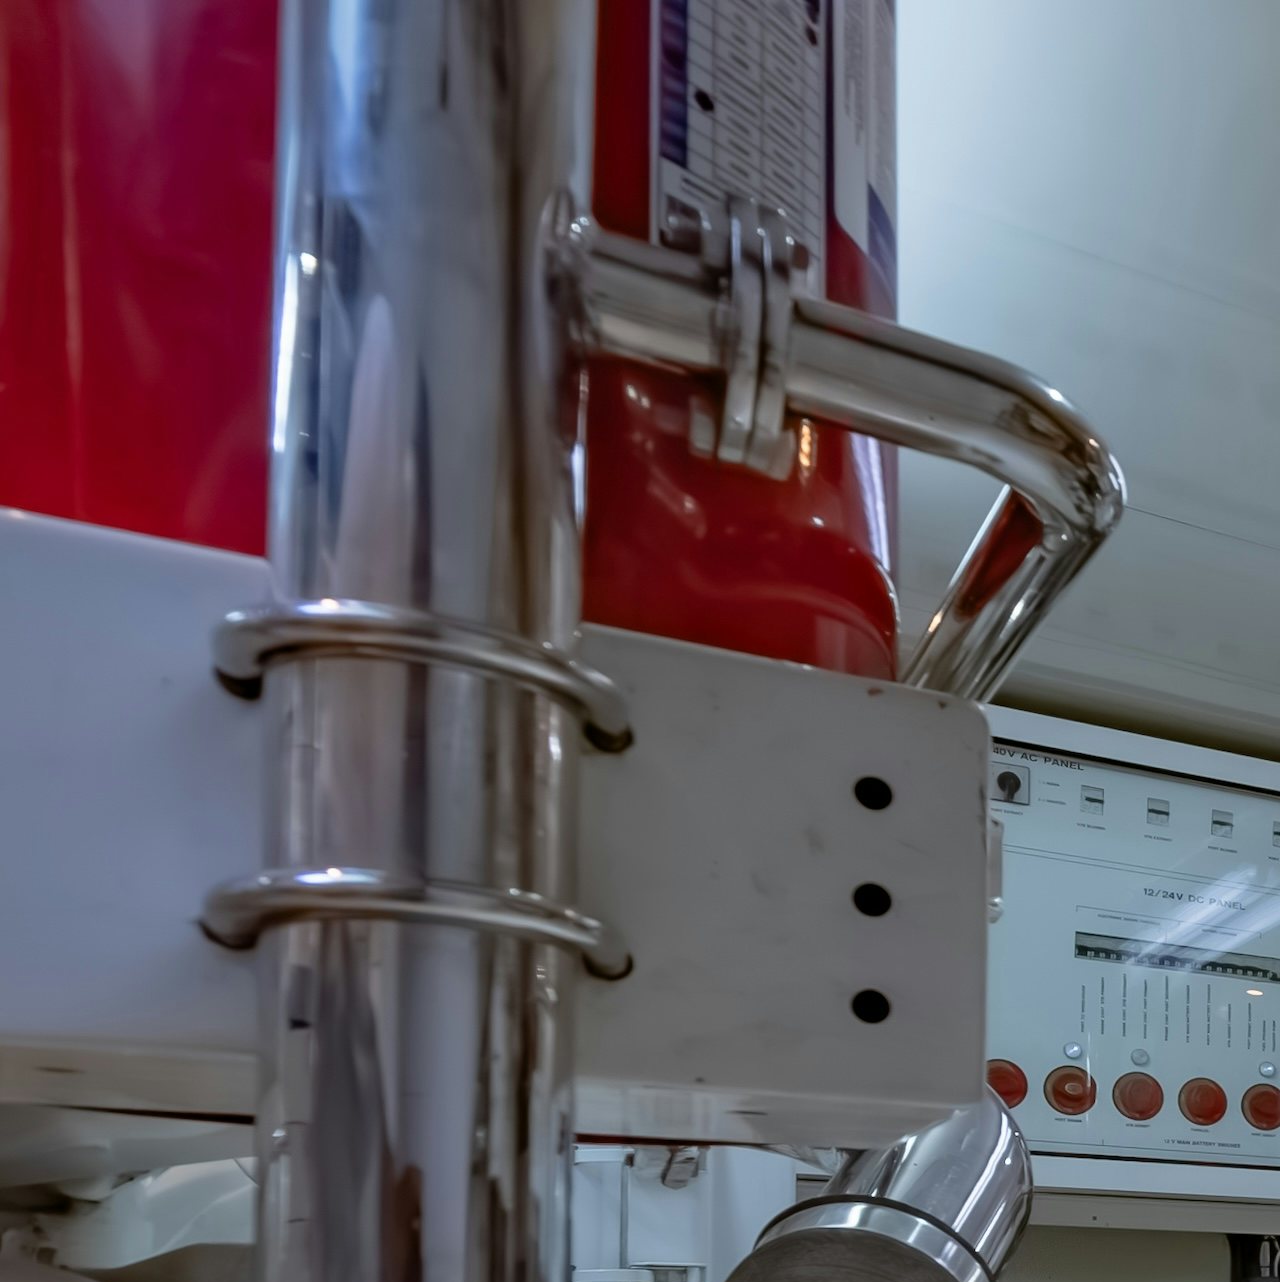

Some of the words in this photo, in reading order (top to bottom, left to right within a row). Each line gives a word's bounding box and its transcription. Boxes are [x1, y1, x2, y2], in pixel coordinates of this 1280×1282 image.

[1020, 752, 1039, 762] AC
[1044, 757, 1084, 771] PANEL
[1143, 888, 1184, 901] 12/24V
[1188, 895, 1205, 904] DC
[1209, 897, 1246, 911] PANEL
